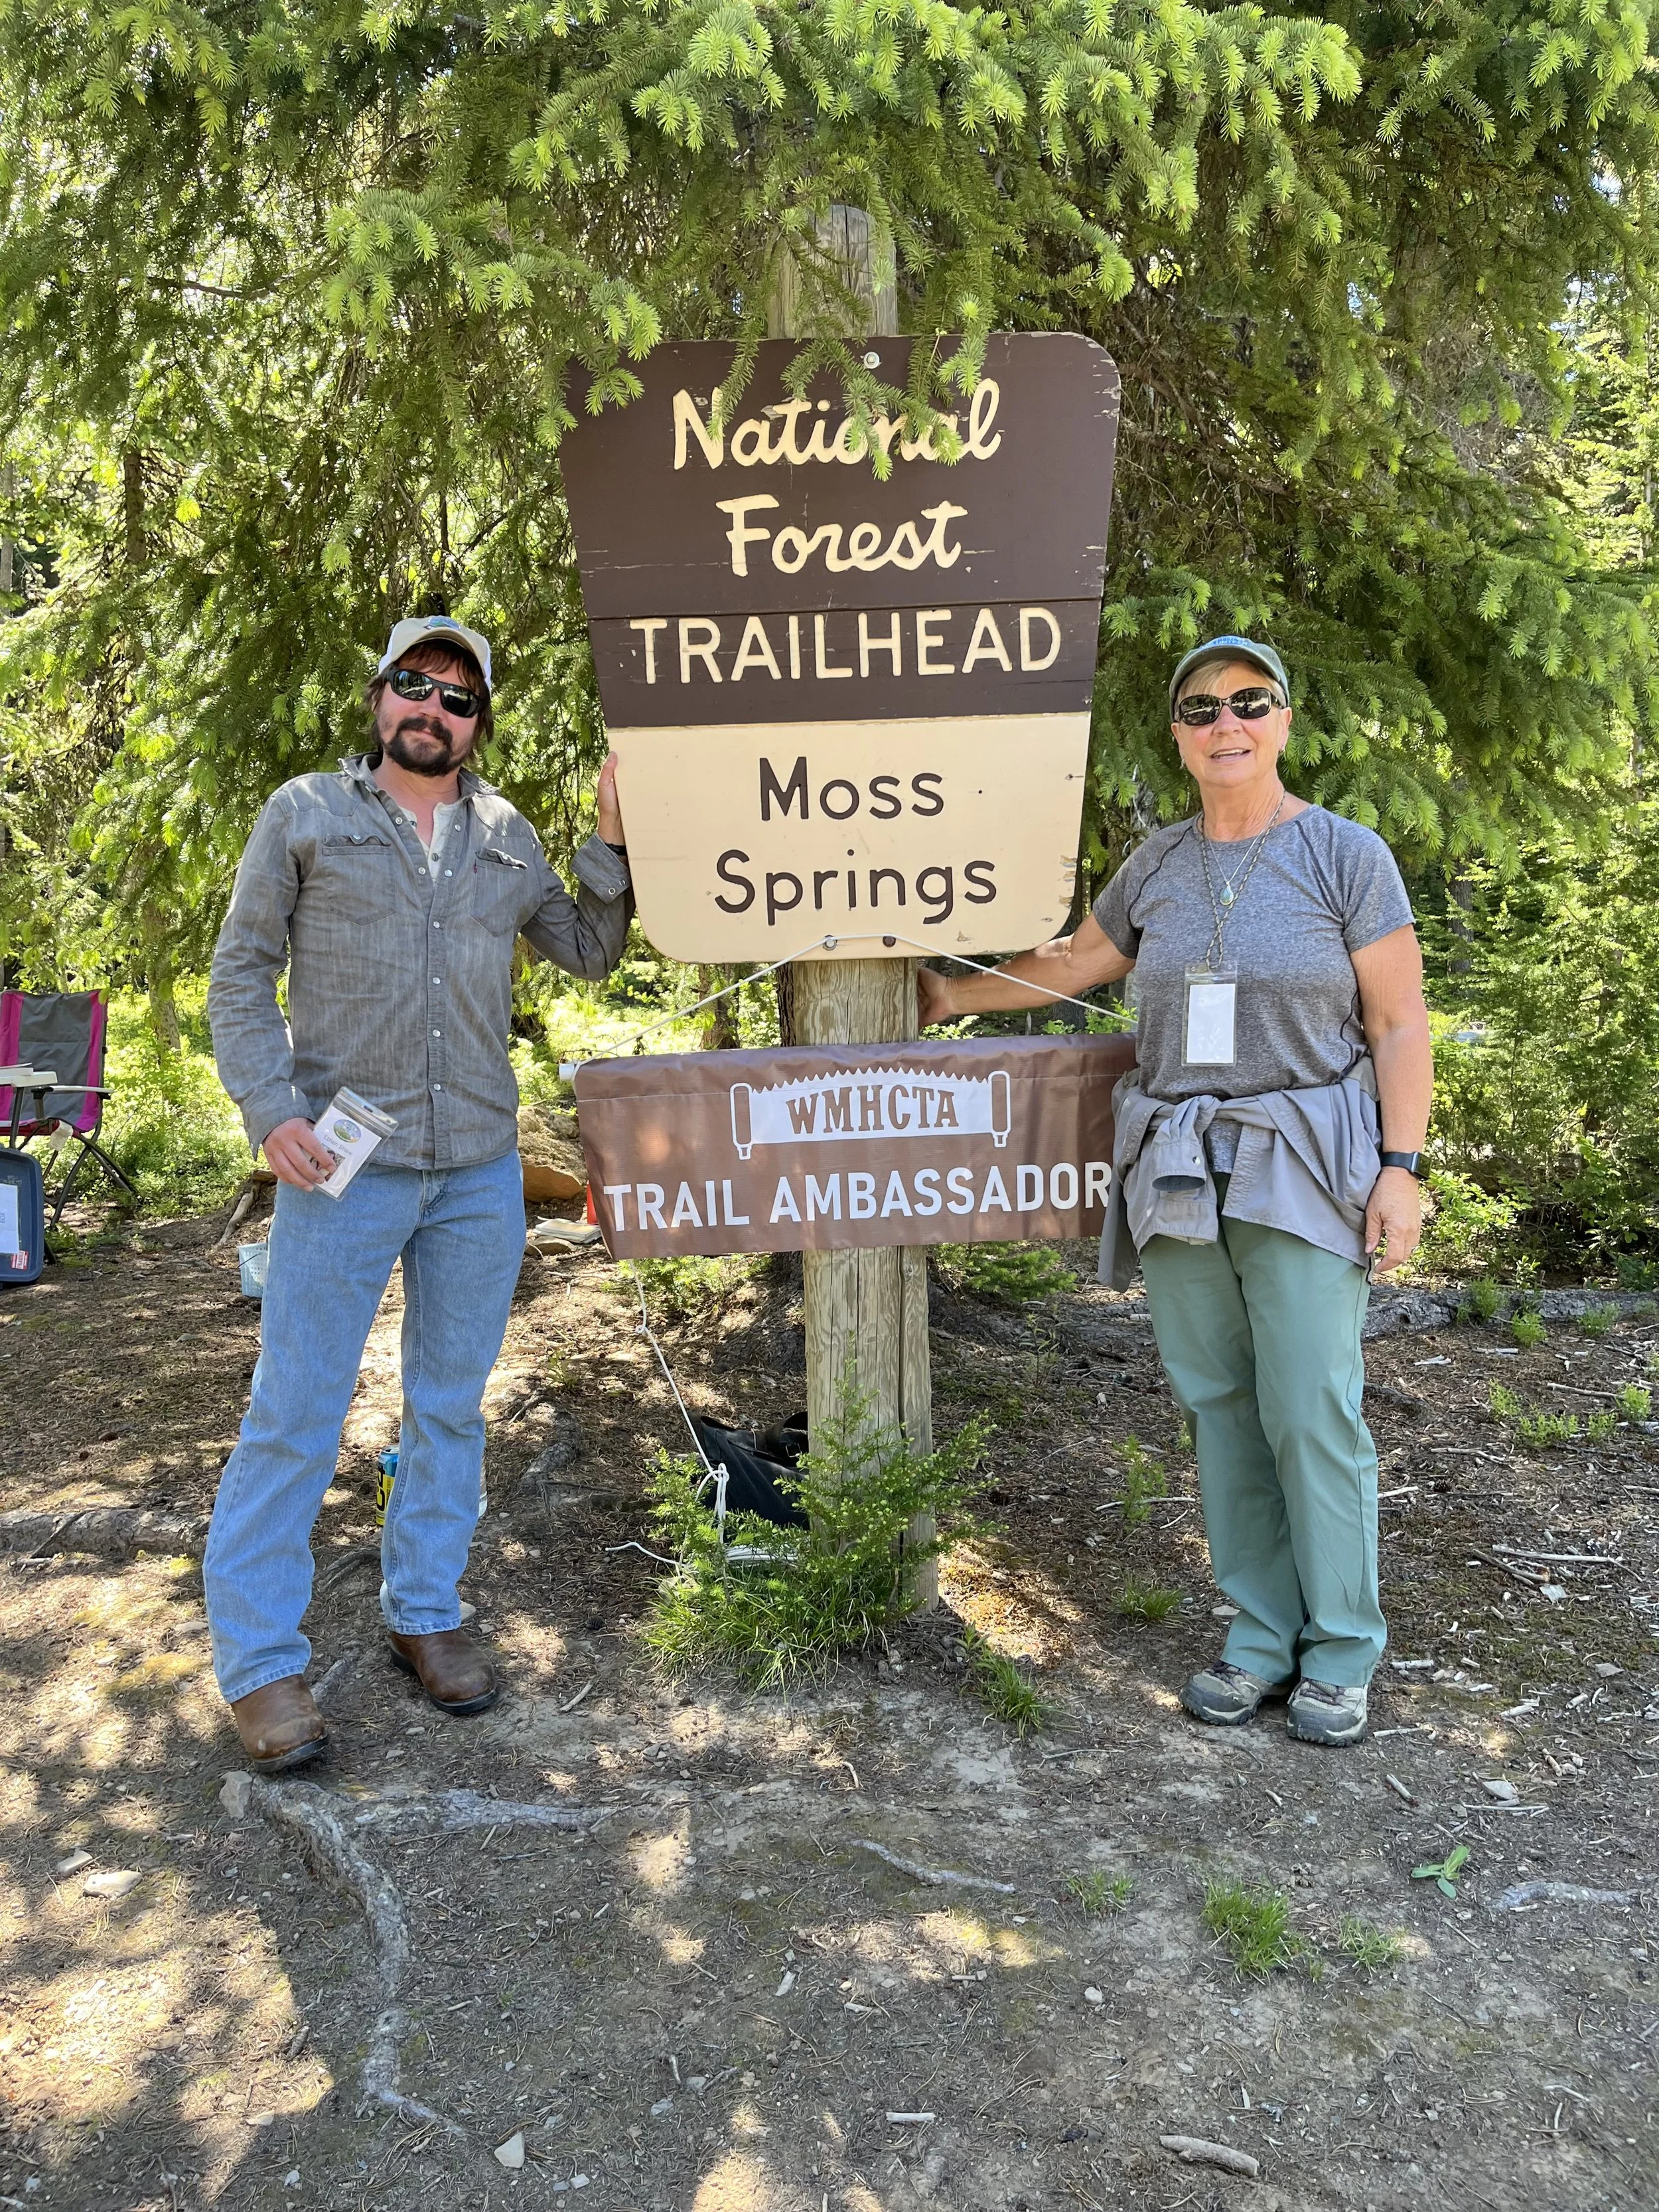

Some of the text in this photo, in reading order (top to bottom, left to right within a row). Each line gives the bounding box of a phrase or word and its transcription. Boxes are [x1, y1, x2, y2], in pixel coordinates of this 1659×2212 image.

[716, 494, 968, 577] Forest
[630, 607, 1062, 684] TRAILHEAD
[759, 756, 944, 821] Moss
[715, 849, 997, 925] Springs
[785, 1084, 960, 1134] WMHCTA
[604, 1161, 1112, 1232] TRAIL AMBASSADOR
